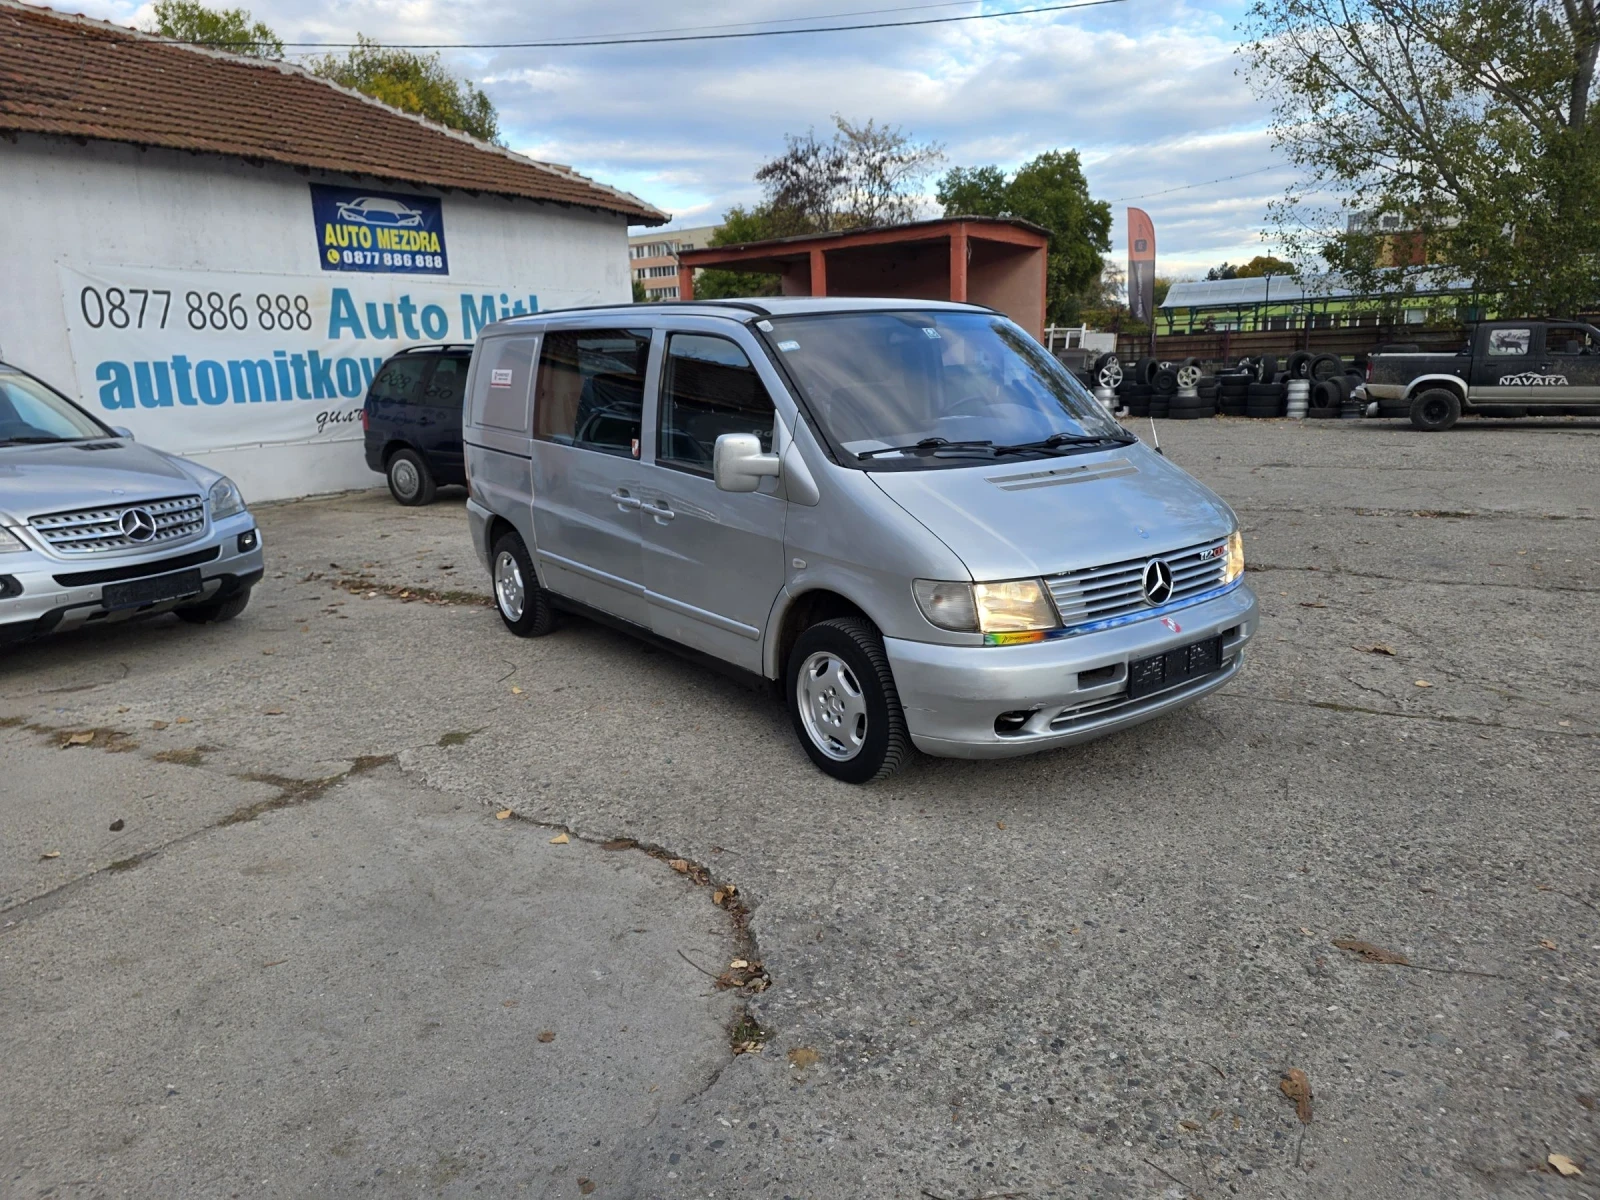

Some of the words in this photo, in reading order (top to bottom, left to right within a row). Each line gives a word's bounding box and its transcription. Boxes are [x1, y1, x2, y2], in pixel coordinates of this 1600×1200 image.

[325, 223, 372, 249] AUTO
[376, 227, 441, 252] MEZDRA
[343, 250, 379, 264] 0877
[383, 252, 412, 267] 886
[415, 255, 442, 268] 888
[81, 286, 171, 329] 0877
[185, 291, 248, 330] 886
[256, 293, 312, 330] 888
[328, 288, 449, 340] Auto
[95, 350, 383, 410] automitkov
[1499, 377, 1569, 385] NAVARA
